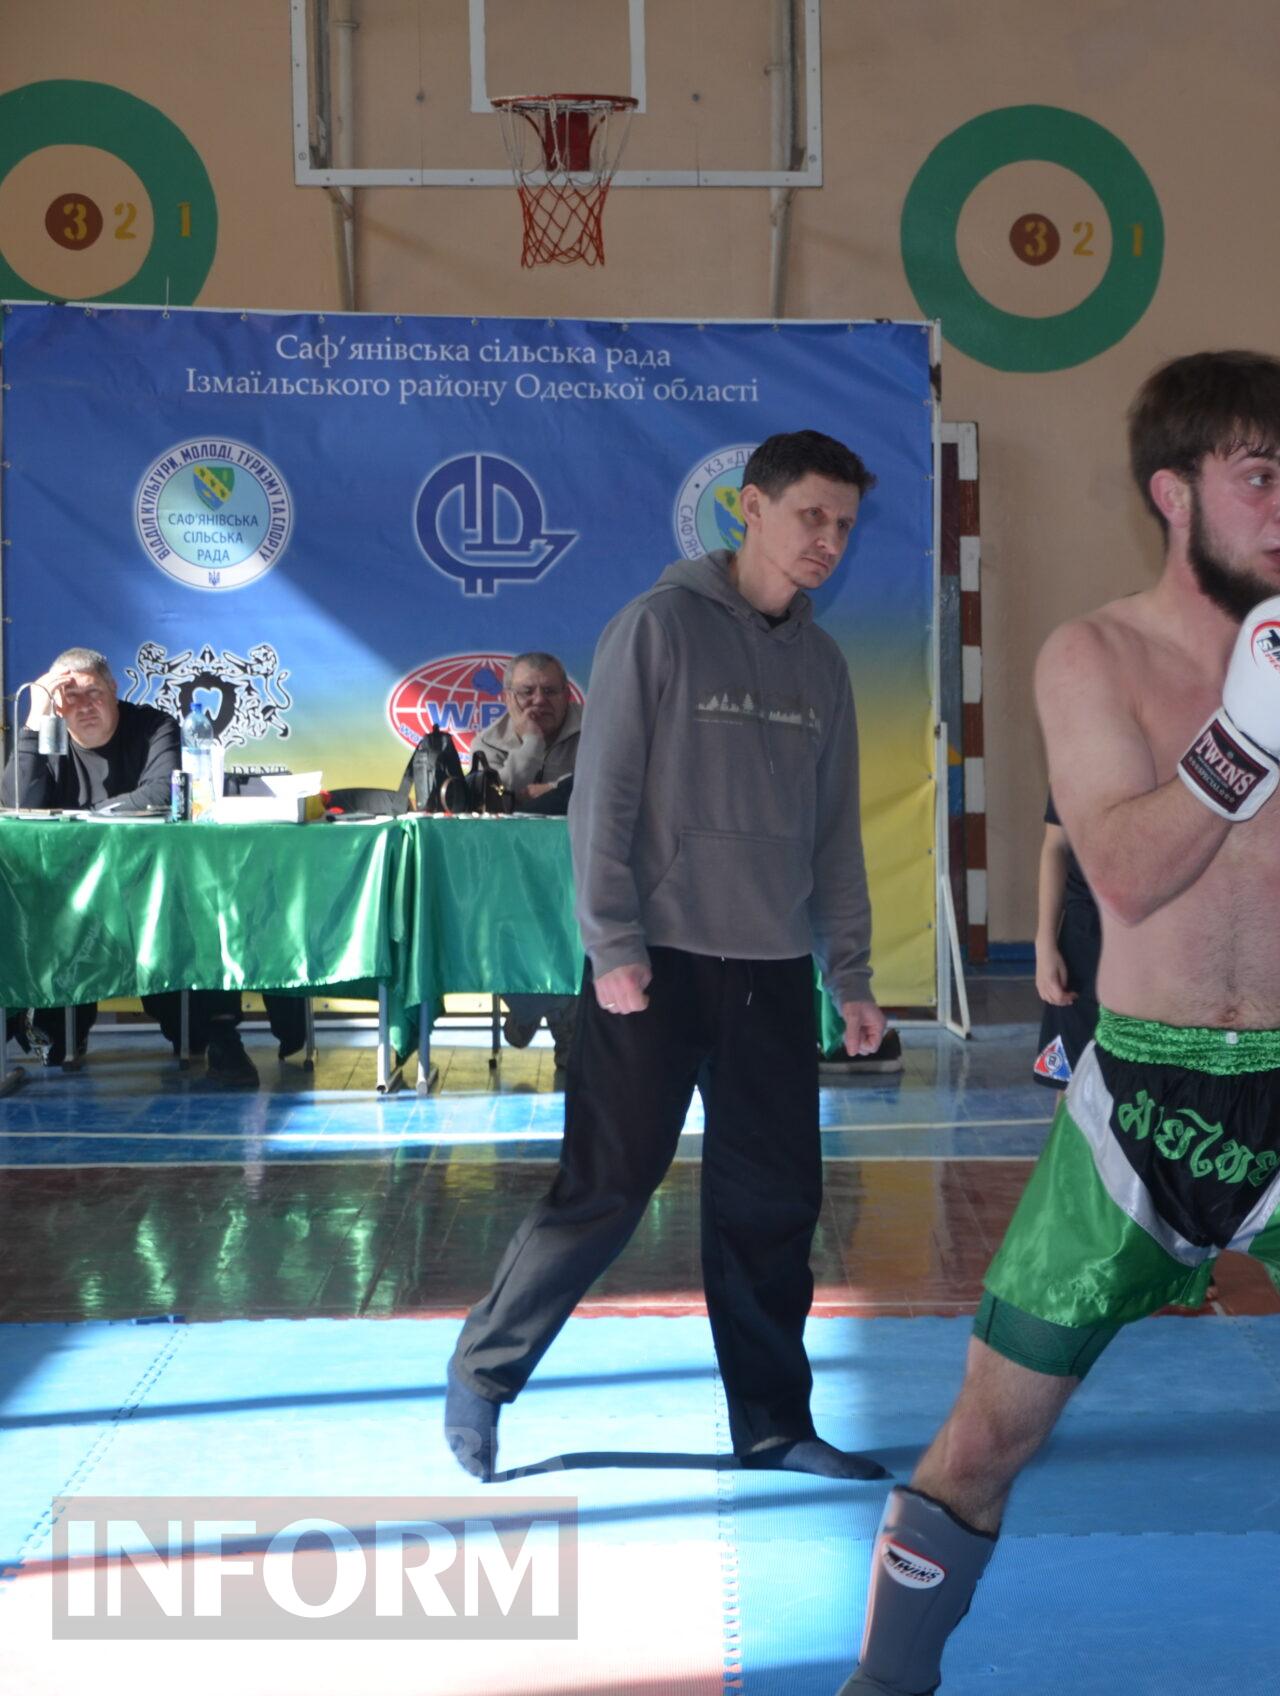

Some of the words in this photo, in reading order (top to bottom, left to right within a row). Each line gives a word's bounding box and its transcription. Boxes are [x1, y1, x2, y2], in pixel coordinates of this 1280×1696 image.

[63, 202, 87, 241] 3
[114, 202, 137, 240] 2
[177, 202, 192, 237] 1
[1024, 221, 1048, 256] 3
[1073, 221, 1095, 257] 2
[1130, 223, 1144, 256] 1
[479, 339, 597, 364] сільська
[606, 347, 671, 373] рада
[185, 368, 390, 397] Ізмаїльського
[399, 374, 507, 406] району
[515, 373, 645, 402] Одеської
[653, 378, 759, 403] області
[237, 450, 282, 497] ТУРИЗМУ
[704, 459, 724, 477] КЗ
[271, 499, 286, 515] ТА
[141, 517, 171, 561] ВІДДІЛ
[183, 531, 244, 545] СІЛЬСЬКА
[197, 549, 230, 564] РАДА
[260, 517, 287, 562] СПОРТУ
[1195, 730, 1256, 795] TWINS
